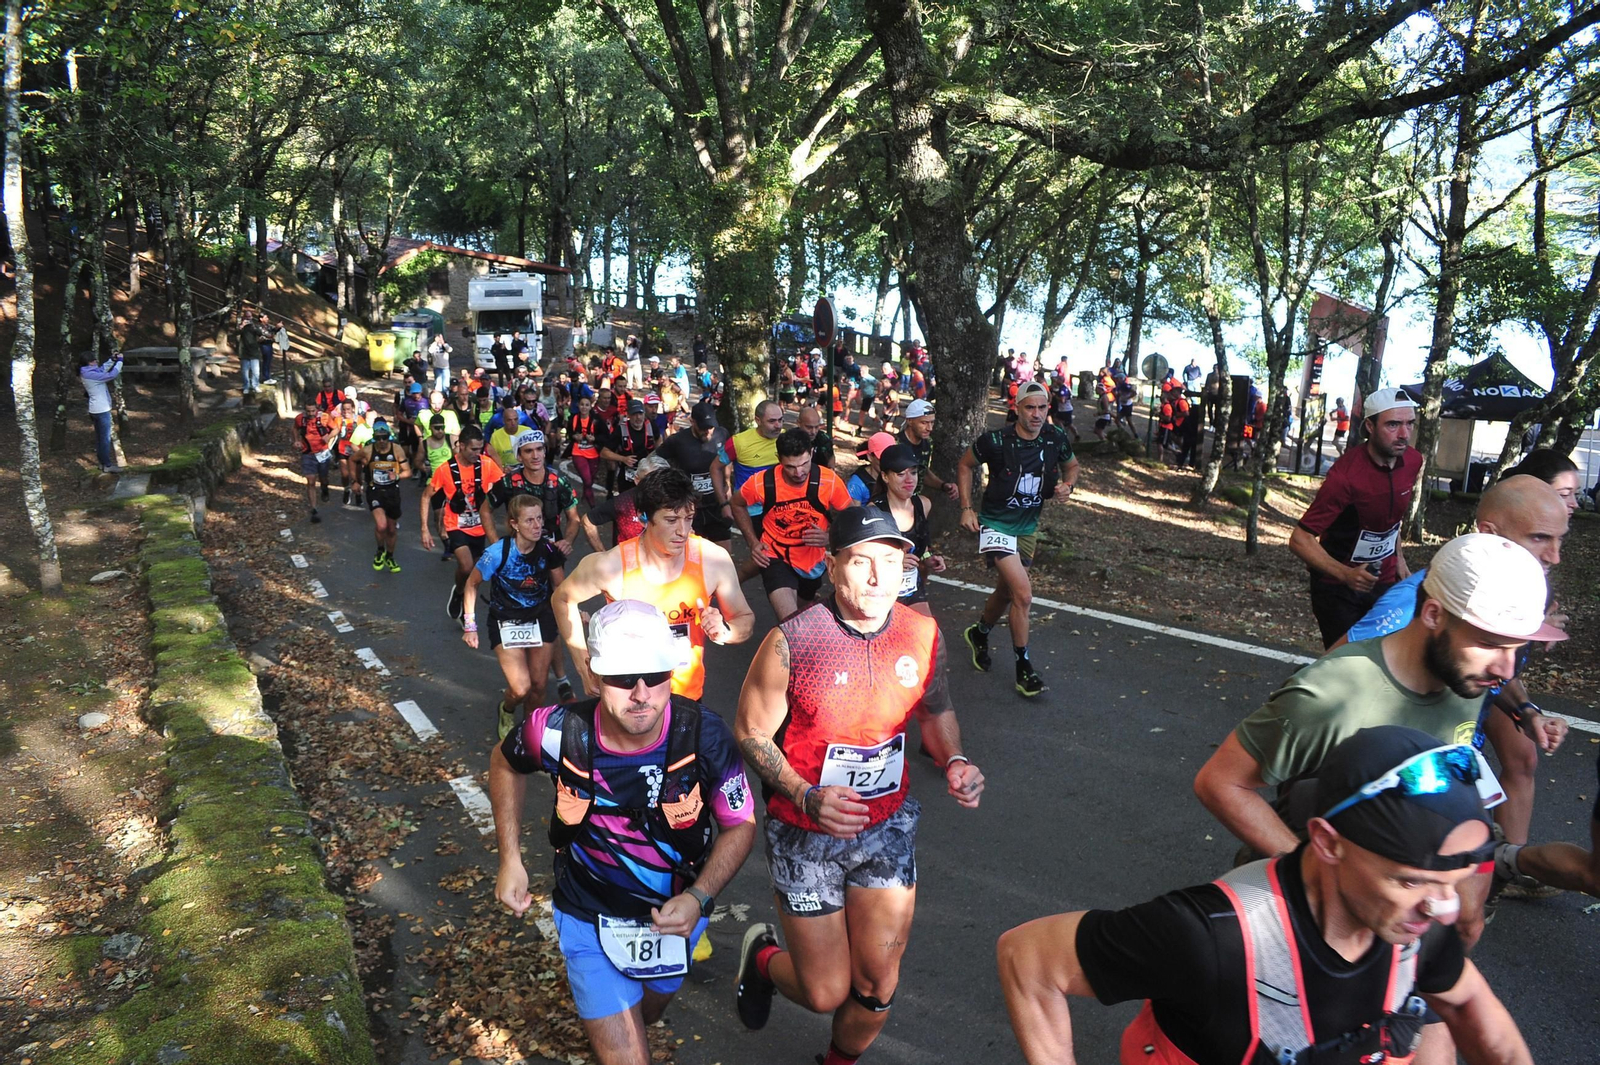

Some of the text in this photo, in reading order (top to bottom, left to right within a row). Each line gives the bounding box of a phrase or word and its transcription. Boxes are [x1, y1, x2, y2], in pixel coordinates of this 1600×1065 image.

[987, 536, 1009, 546] 245
[1369, 542, 1389, 556] 192
[510, 631, 532, 640] 202
[846, 768, 886, 787] 127
[626, 938, 662, 962] 181
